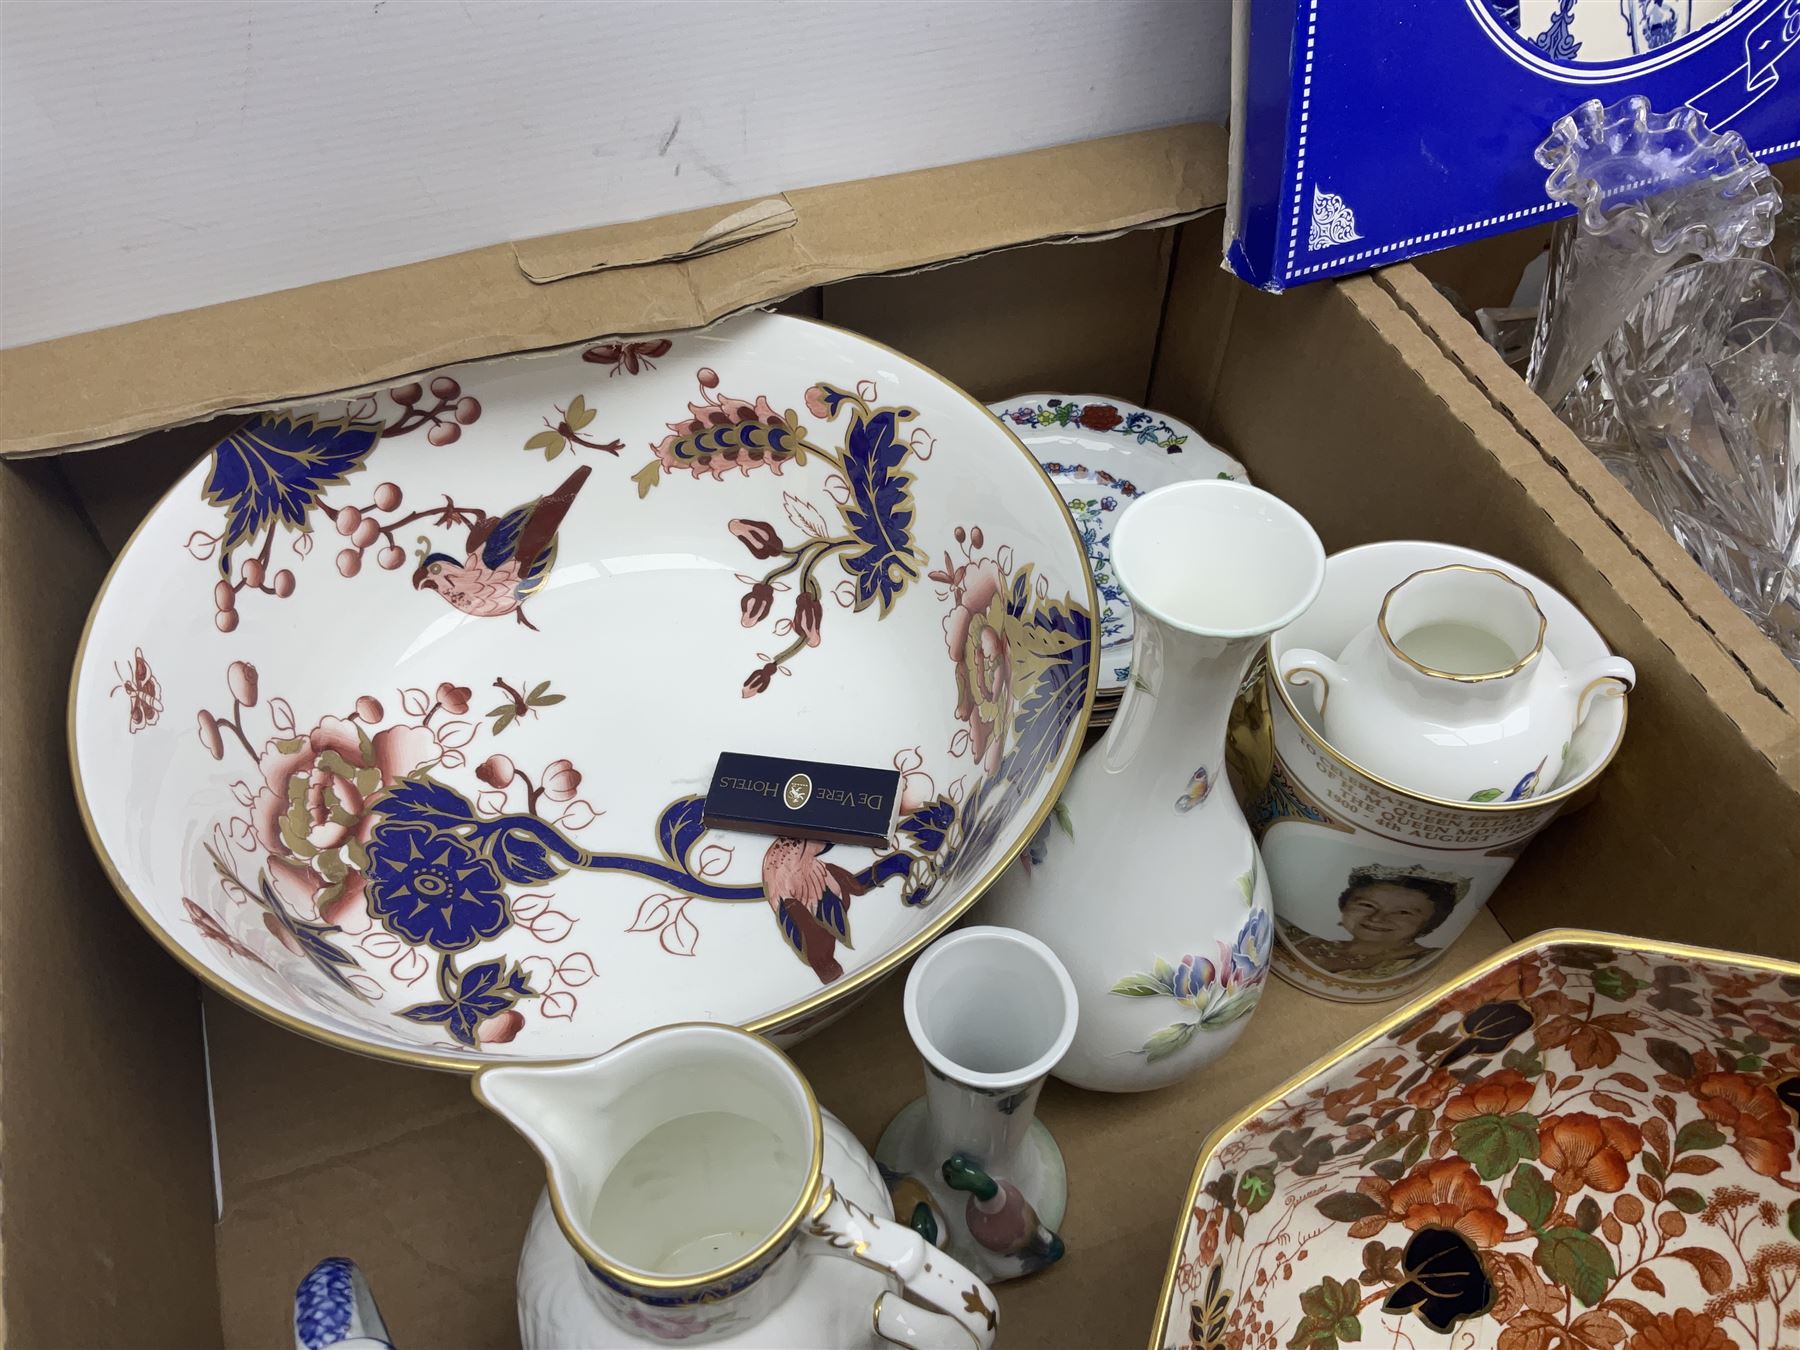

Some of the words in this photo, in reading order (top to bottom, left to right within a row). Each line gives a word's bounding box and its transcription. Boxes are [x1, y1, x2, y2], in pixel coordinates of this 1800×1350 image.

[719, 776, 779, 798] HOTELS
[1320, 756, 1418, 811] CELEBRATE
[1424, 808, 1462, 819] THE
[1326, 788, 1358, 813] 1900
[1375, 818, 1401, 832] 4th
[1408, 830, 1490, 843] AUGUST
[1340, 788, 1375, 813] THE
[1381, 811, 1451, 834] QUEEN
[1393, 807, 1463, 828] QUEEN
